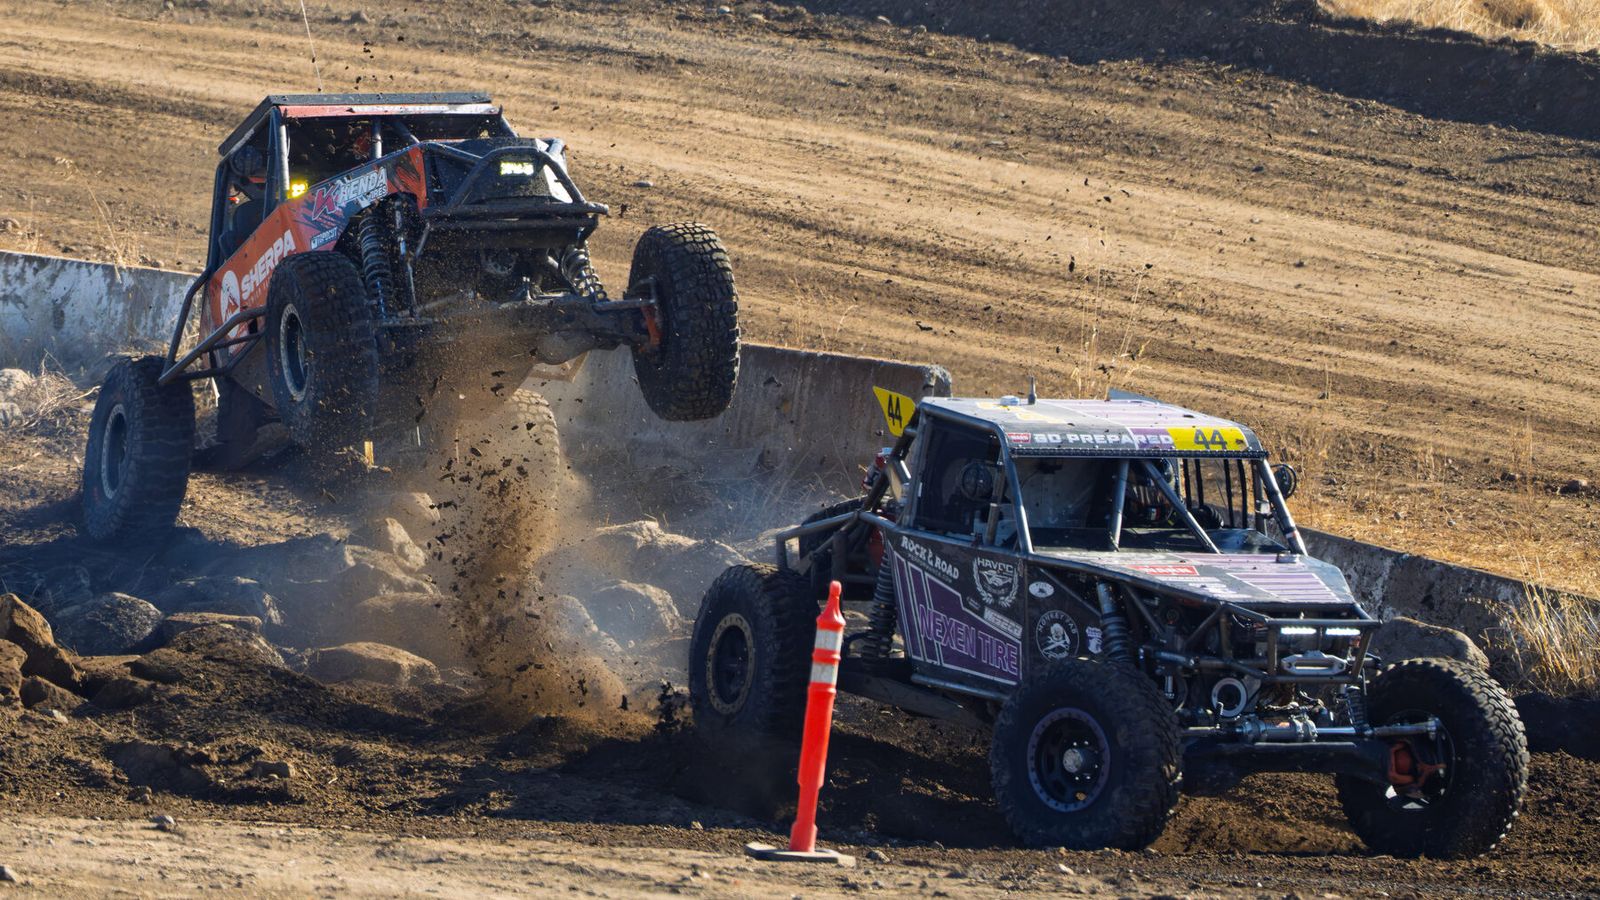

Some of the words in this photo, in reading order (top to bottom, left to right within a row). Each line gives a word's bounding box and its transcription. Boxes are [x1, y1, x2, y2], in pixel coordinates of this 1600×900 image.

[241, 229, 296, 300] SHERPA
[887, 394, 903, 429] 44
[1066, 432, 1175, 445] PREPARED
[1194, 428, 1229, 450] 44
[900, 535, 927, 561] ROCK
[934, 555, 960, 580] ROAD
[977, 557, 1014, 574] HAVOC
[919, 603, 977, 659] NEXEN
[977, 630, 1018, 676] TIRE
